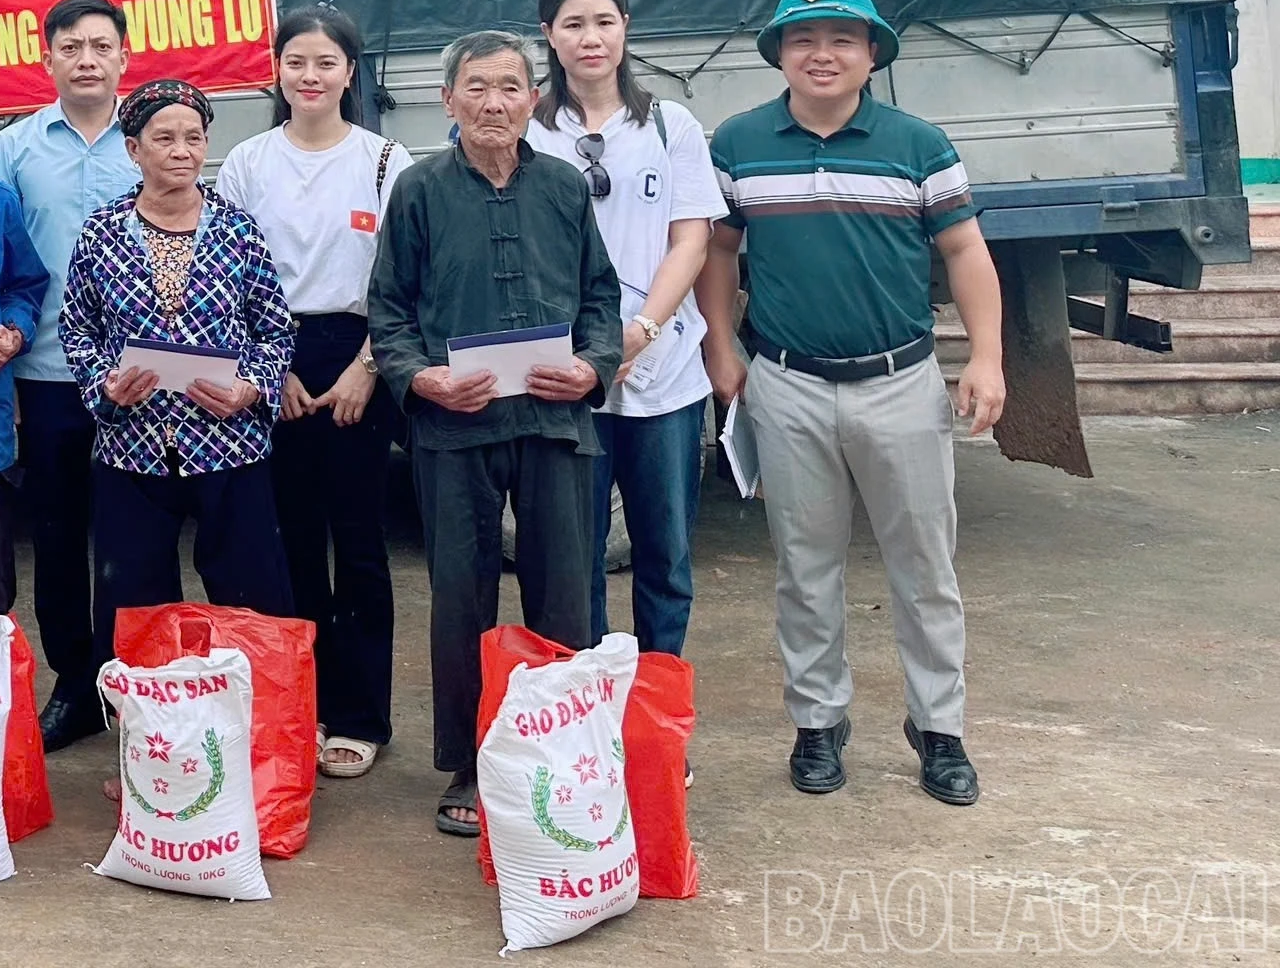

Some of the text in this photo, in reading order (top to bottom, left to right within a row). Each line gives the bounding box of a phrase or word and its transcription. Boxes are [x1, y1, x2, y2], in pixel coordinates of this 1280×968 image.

[644, 174, 656, 197] C
[151, 831, 240, 863] HƯƠNG
[198, 867, 226, 881] 10KG
